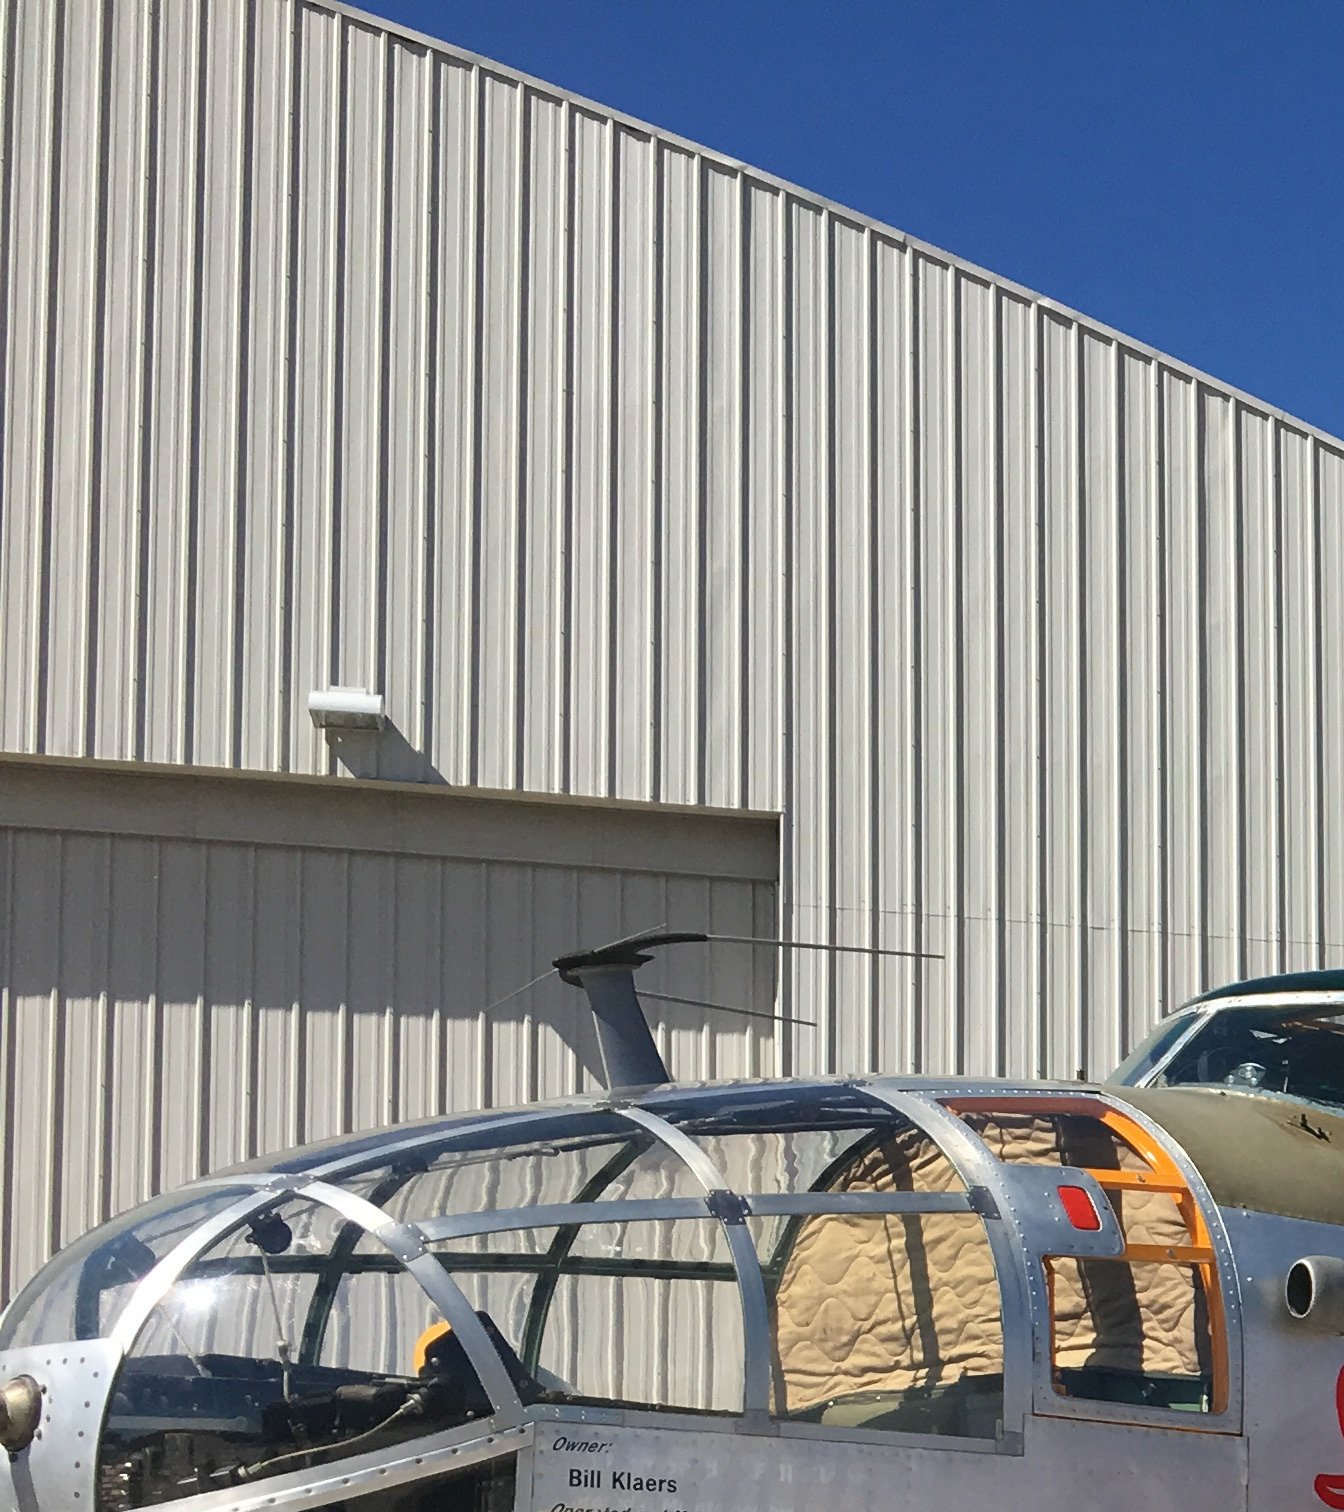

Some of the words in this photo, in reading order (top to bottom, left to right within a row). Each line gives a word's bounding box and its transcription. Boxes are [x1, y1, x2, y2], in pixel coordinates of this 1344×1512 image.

[552, 1436, 613, 1454] Owner:
[568, 1468, 602, 1489] Bill
[611, 1470, 678, 1494] Klaers
